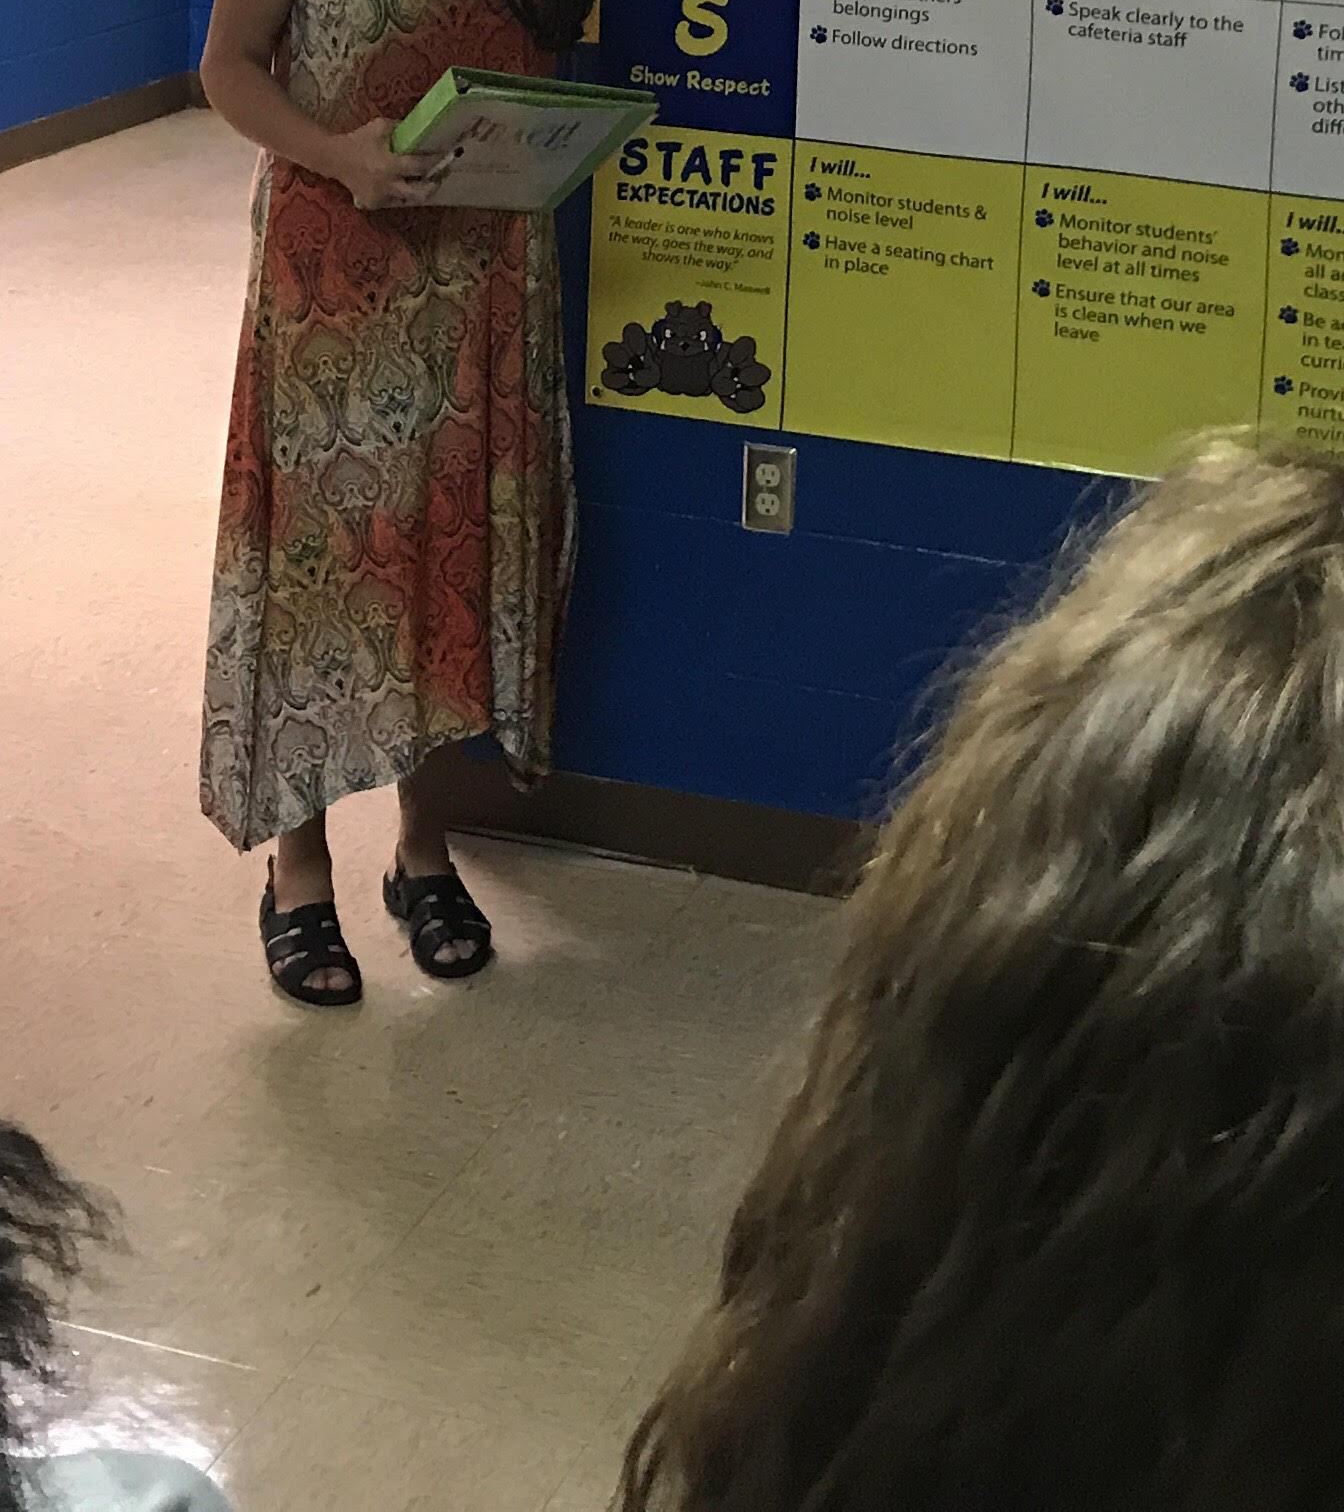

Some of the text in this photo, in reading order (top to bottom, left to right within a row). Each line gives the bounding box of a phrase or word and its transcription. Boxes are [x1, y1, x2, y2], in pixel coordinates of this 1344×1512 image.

[1067, 22, 1188, 47] cafeteria staff
[629, 65, 771, 96] Show Respect
[618, 138, 778, 191] STAFF
[616, 182, 776, 217] EXPECTATIONS
[624, 216, 664, 232] leader
[664, 221, 675, 234] is
[676, 224, 701, 237] one
[702, 226, 731, 241] who
[732, 228, 775, 245] knows
[826, 207, 913, 230] noise level
[1058, 232, 1229, 266] behavior and noise
